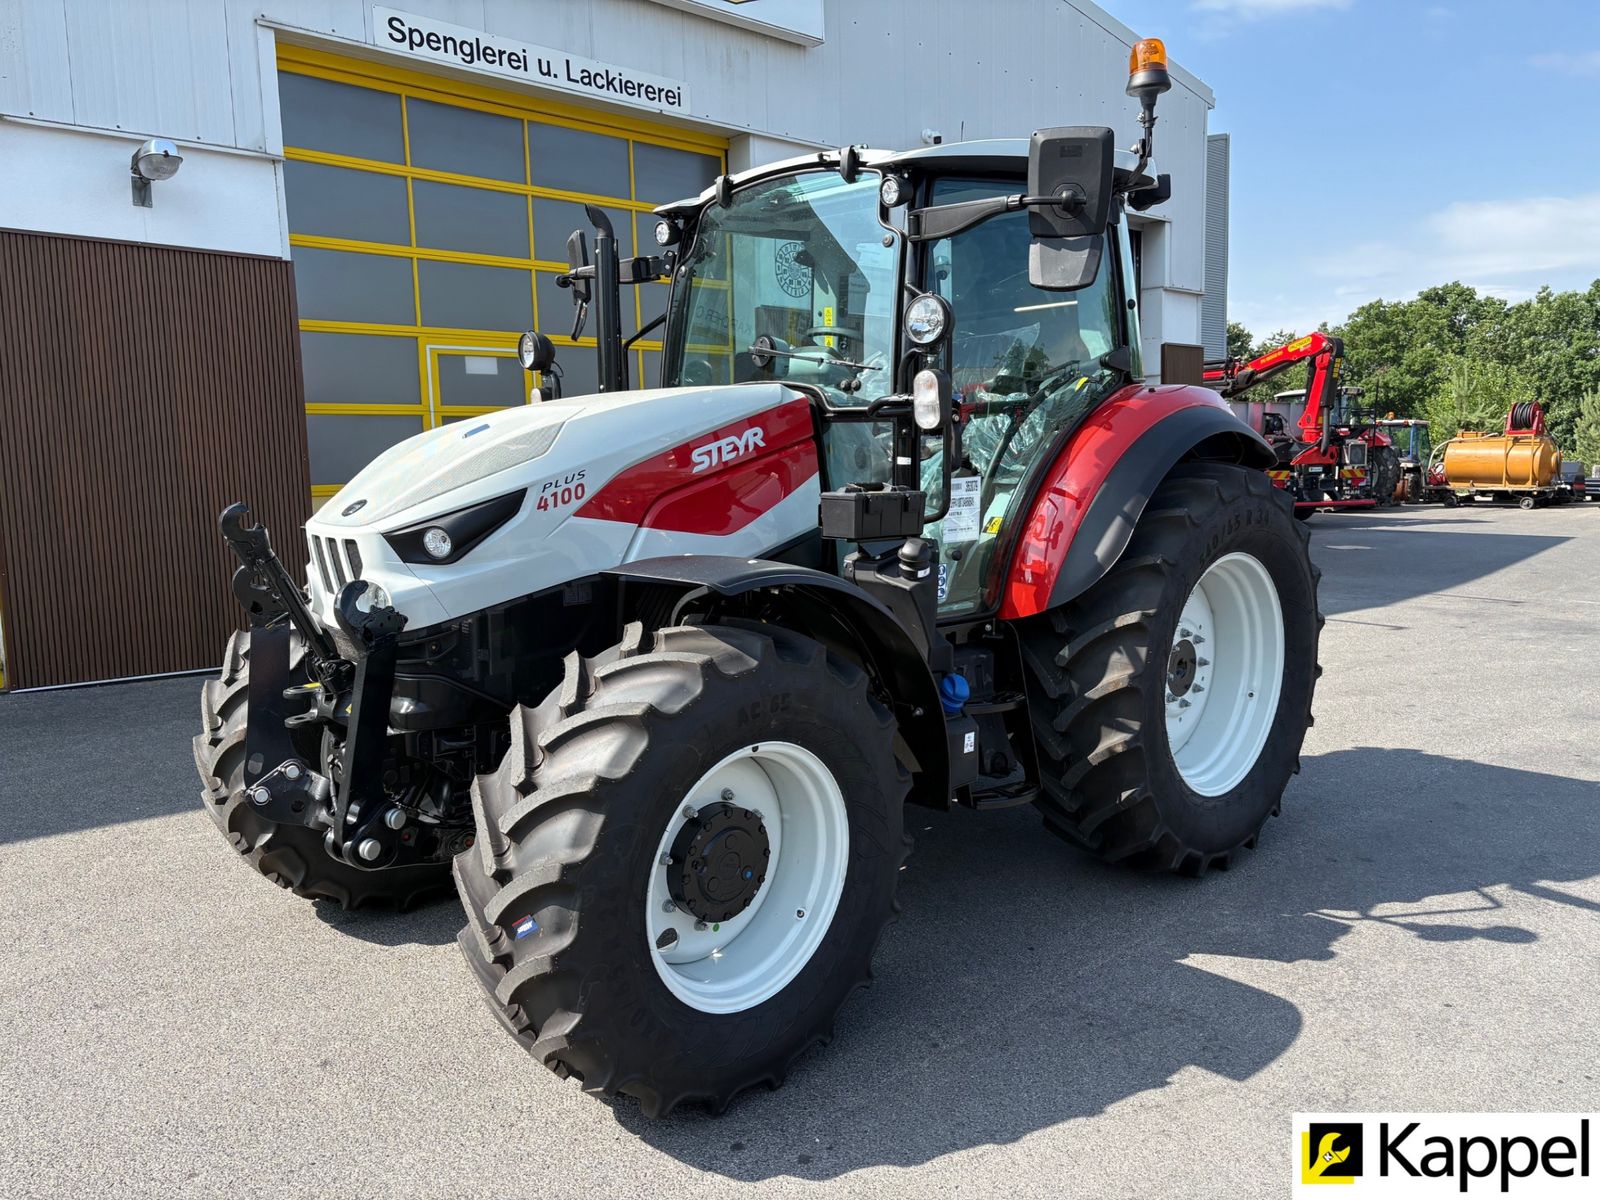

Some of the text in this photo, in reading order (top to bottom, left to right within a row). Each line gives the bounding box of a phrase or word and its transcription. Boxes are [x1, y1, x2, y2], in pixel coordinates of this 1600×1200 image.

[387, 16, 682, 108] Spenglerei u. Lackiererei
[692, 426, 766, 474] STEYR
[536, 483, 585, 511] 4100
[541, 469, 586, 493] PLUS
